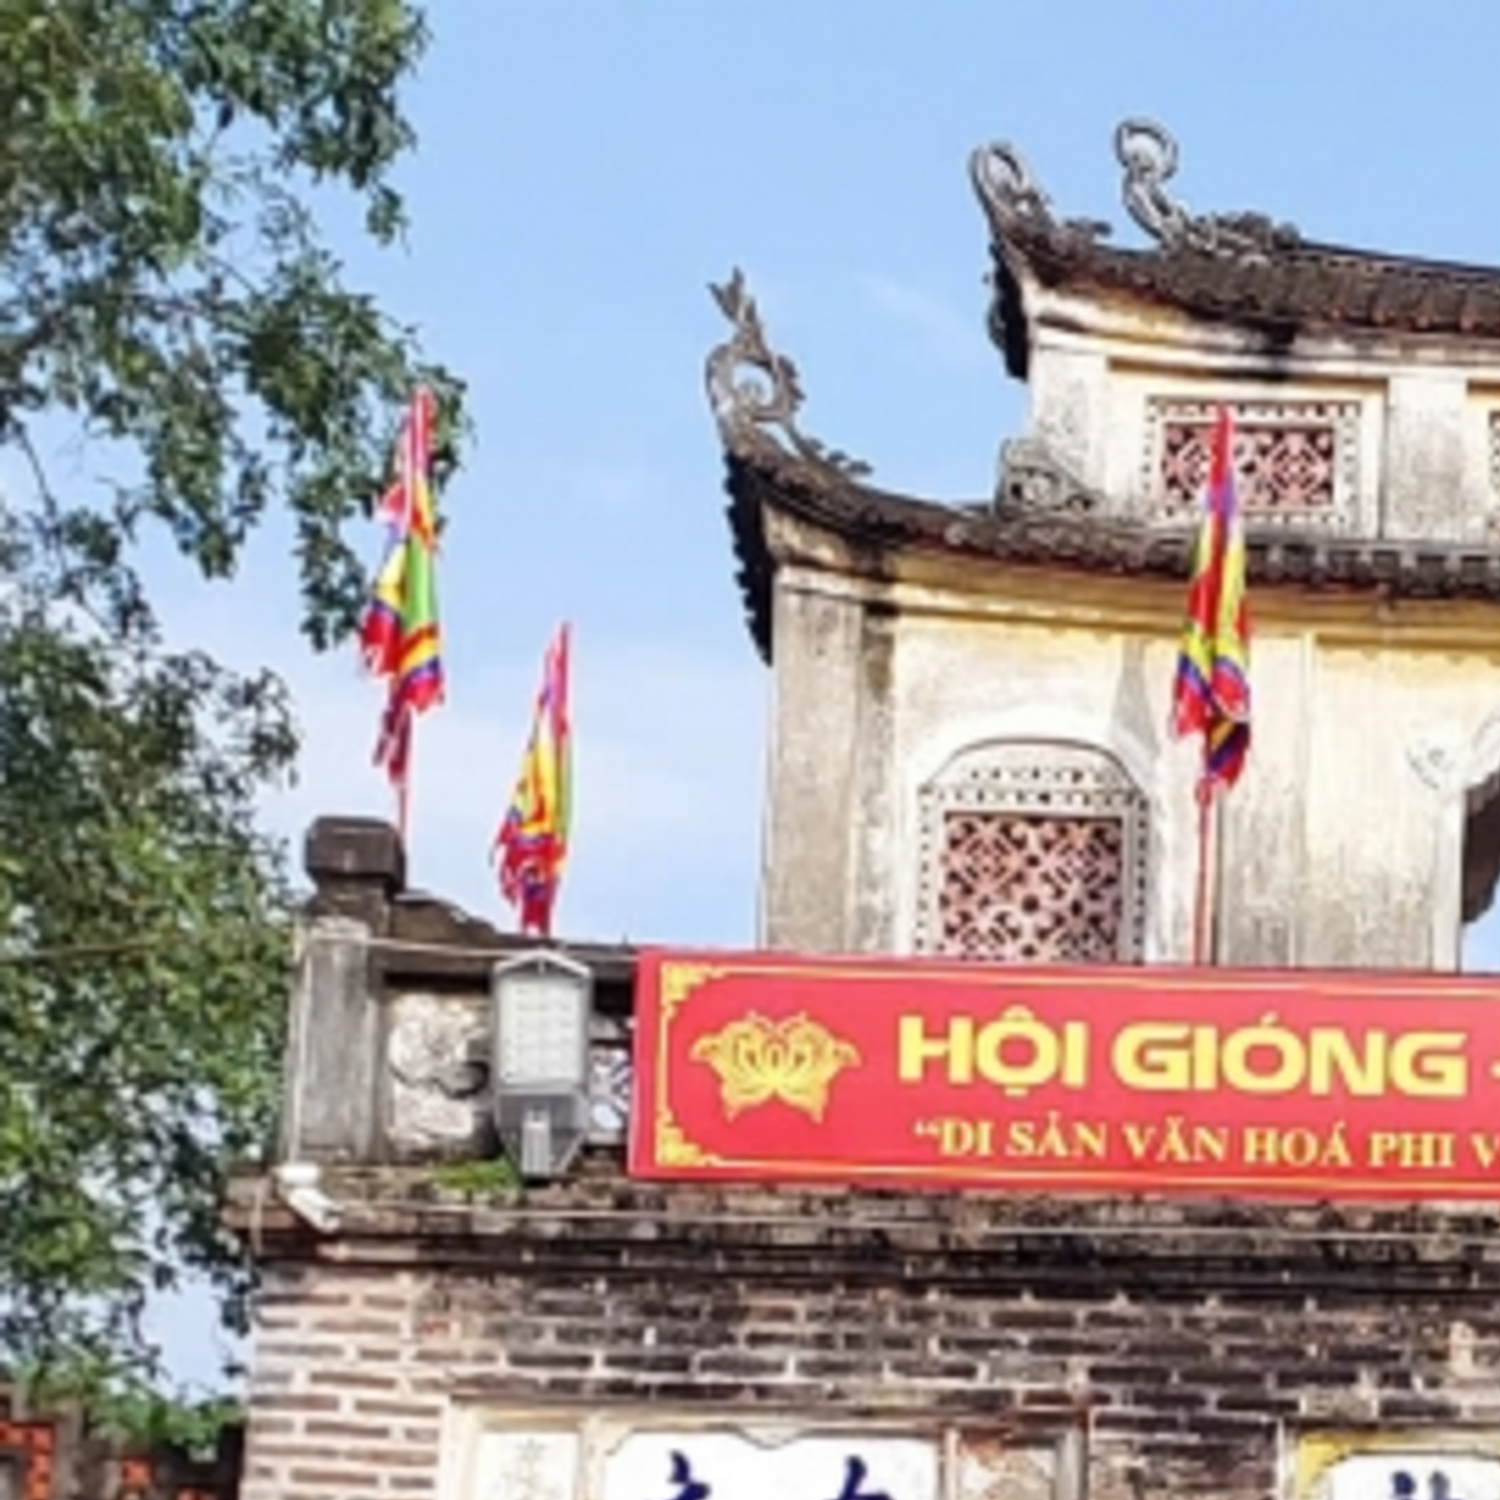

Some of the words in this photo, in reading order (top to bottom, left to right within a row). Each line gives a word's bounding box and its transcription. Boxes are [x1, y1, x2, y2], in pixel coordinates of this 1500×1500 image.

[899, 1004, 1086, 1097] HỘI
[1112, 1011, 1468, 1098] GIÓNG
[1005, 1110, 1108, 1157] SẢN
[1122, 1116, 1229, 1162] VĂN
[1243, 1121, 1353, 1167] HOÁ
[1367, 1132, 1455, 1169] PHI
